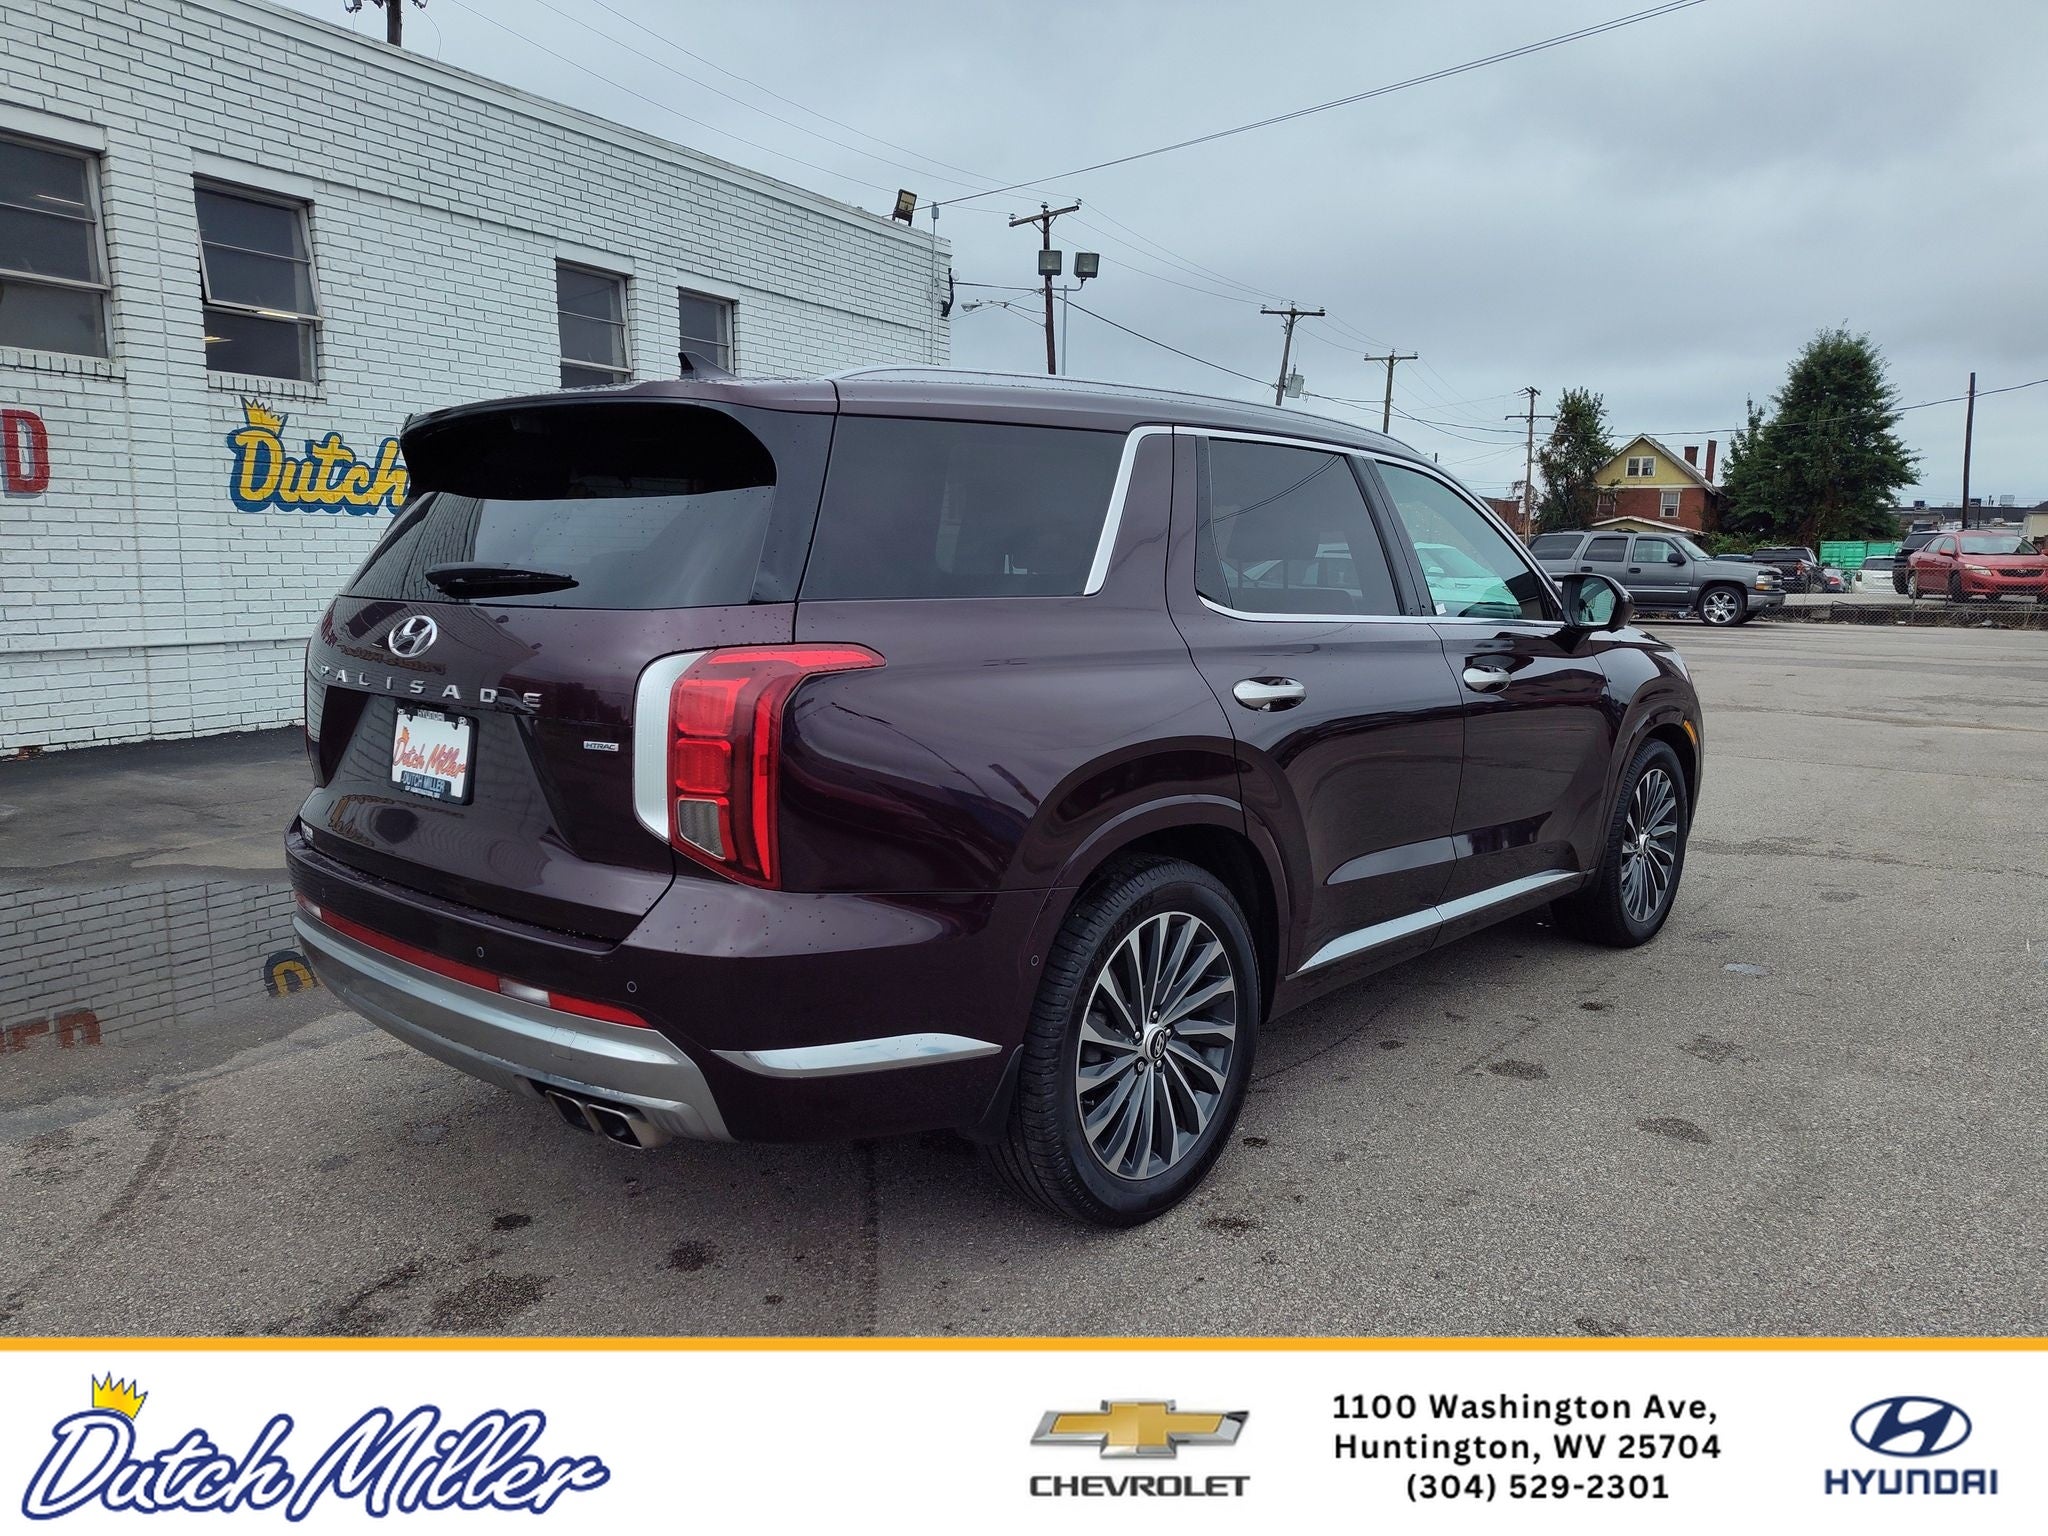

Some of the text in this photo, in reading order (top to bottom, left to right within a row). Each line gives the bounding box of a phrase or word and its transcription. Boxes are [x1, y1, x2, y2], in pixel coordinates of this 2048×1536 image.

[228, 427, 410, 514] Dutch
[320, 665, 543, 709] PALISADE
[393, 737, 466, 779] Dutch Miller
[585, 742, 617, 751] HTRAC
